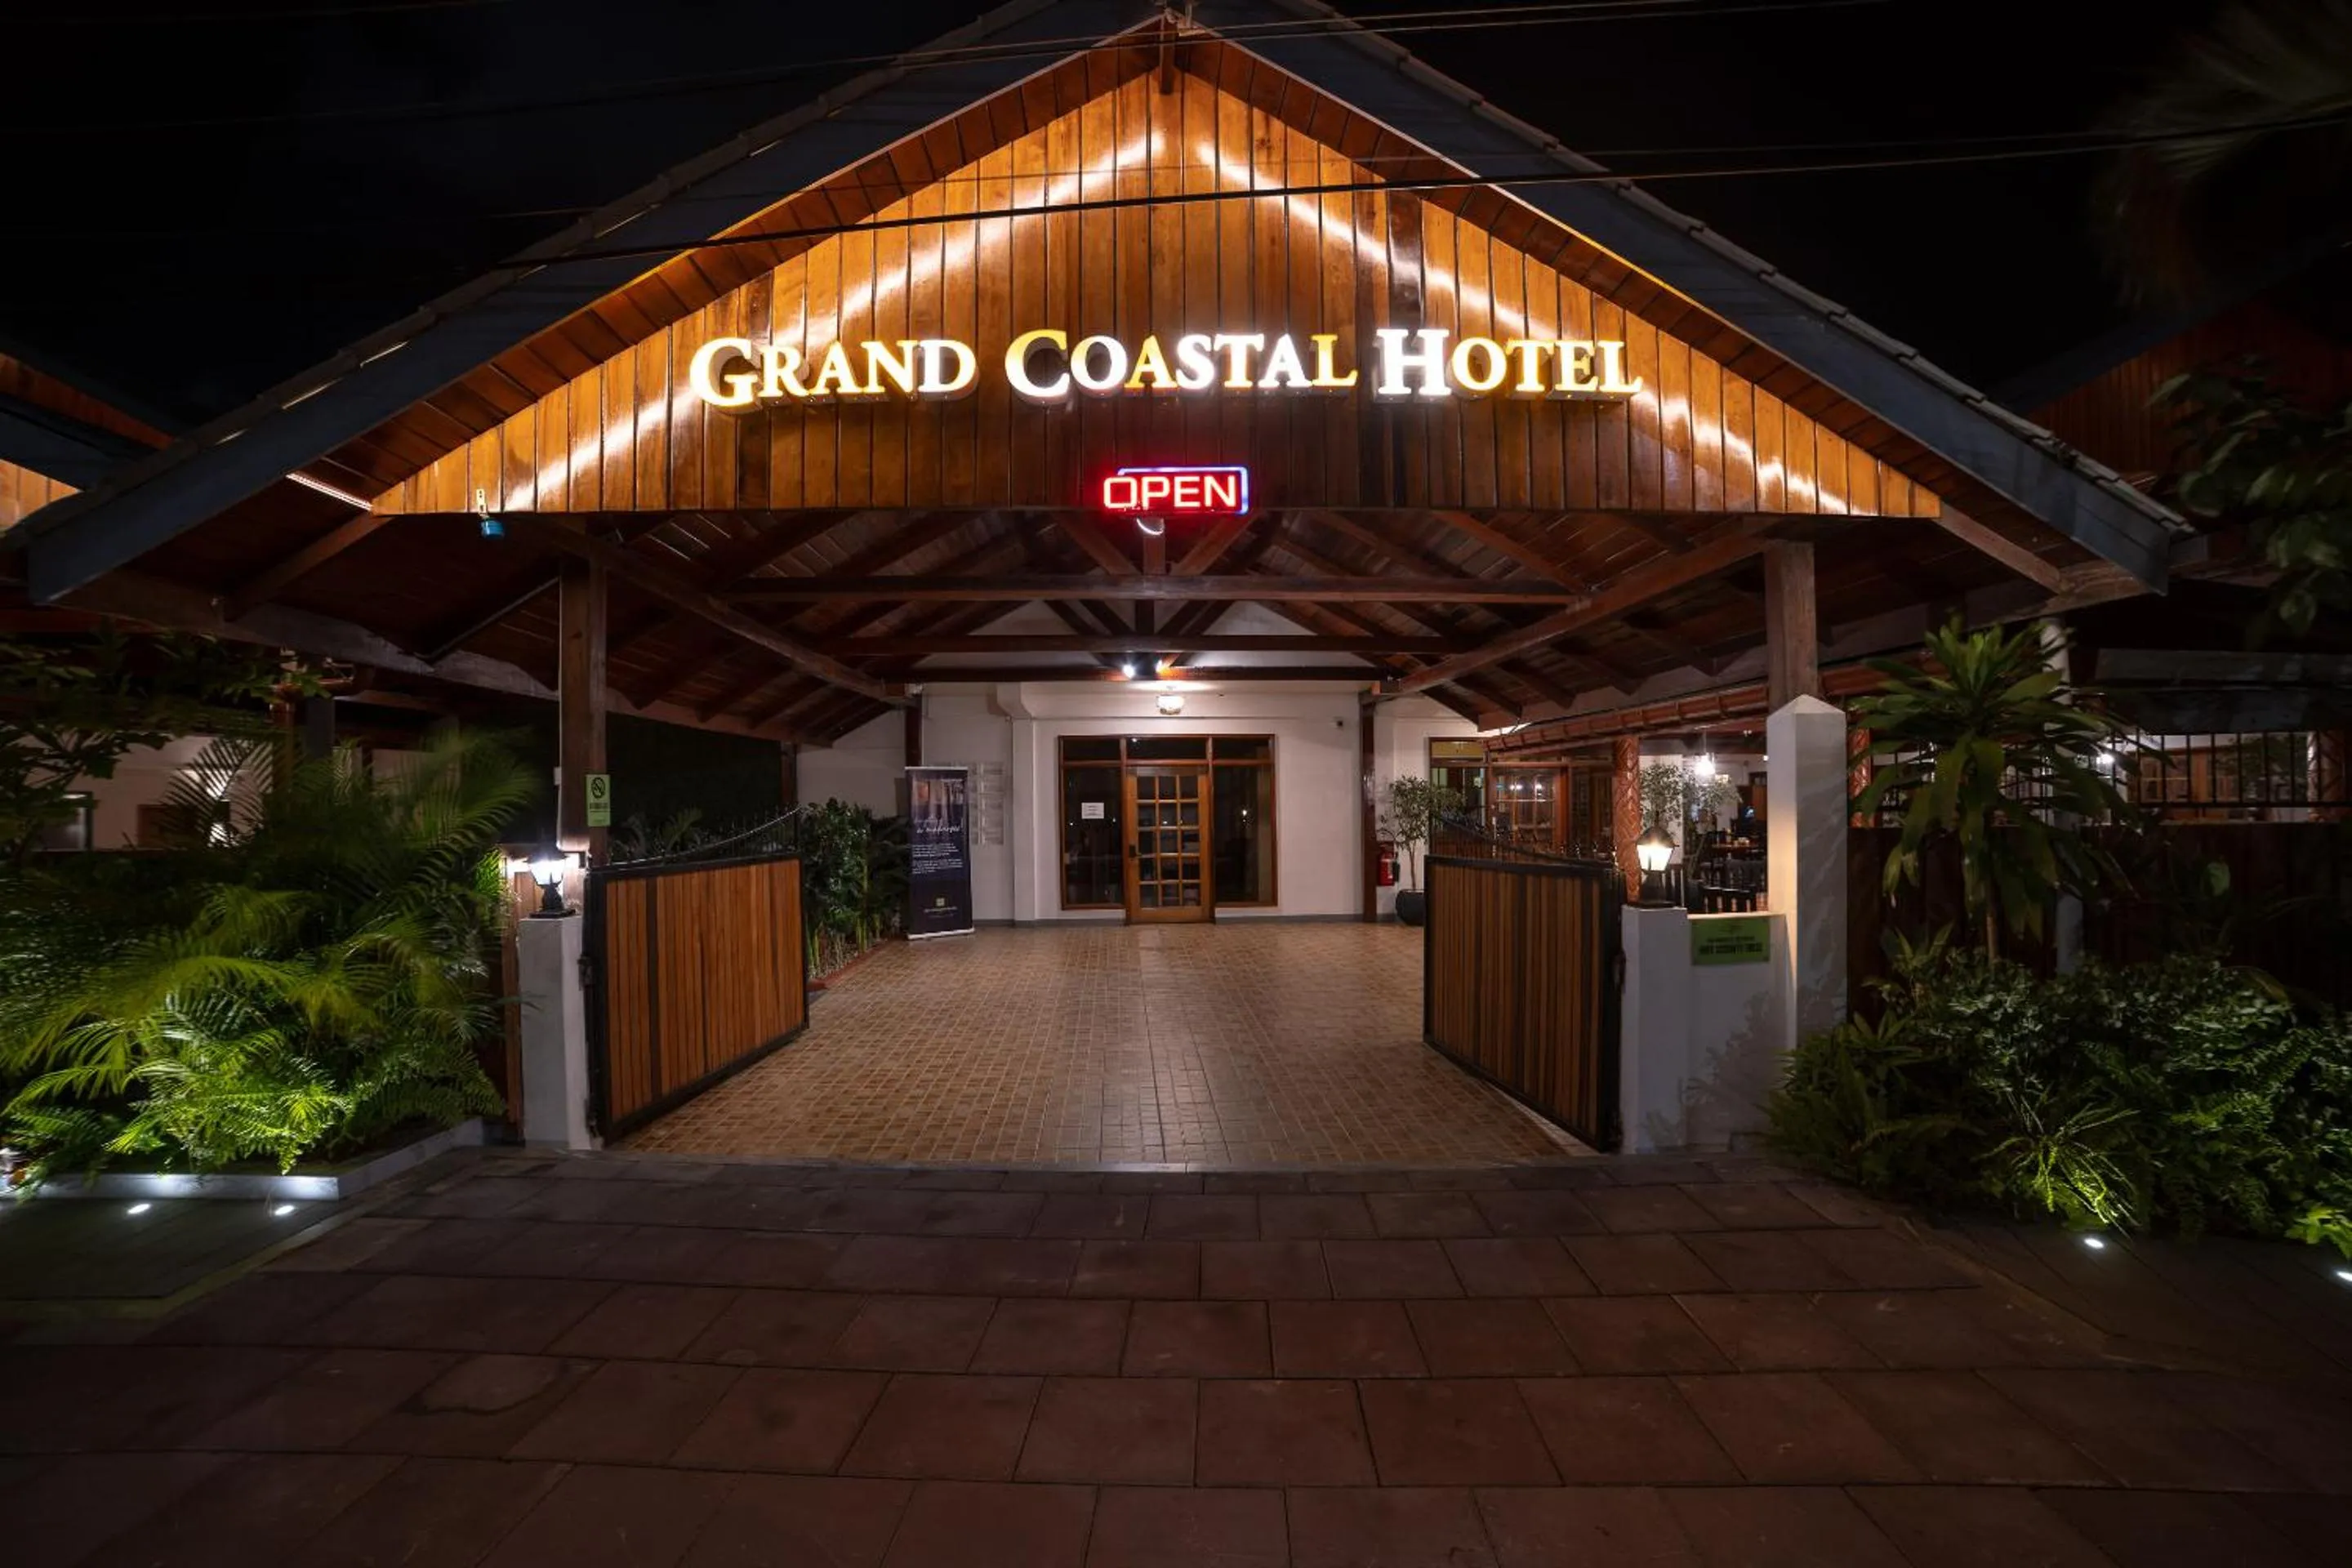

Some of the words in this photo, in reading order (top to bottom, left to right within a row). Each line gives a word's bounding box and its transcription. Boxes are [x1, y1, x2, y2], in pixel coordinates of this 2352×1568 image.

[689, 336, 977, 407] GRAND
[1004, 329, 1358, 398] COASTAL
[1375, 328, 1642, 396] HOTEL
[1103, 475, 1236, 509] OPEN
